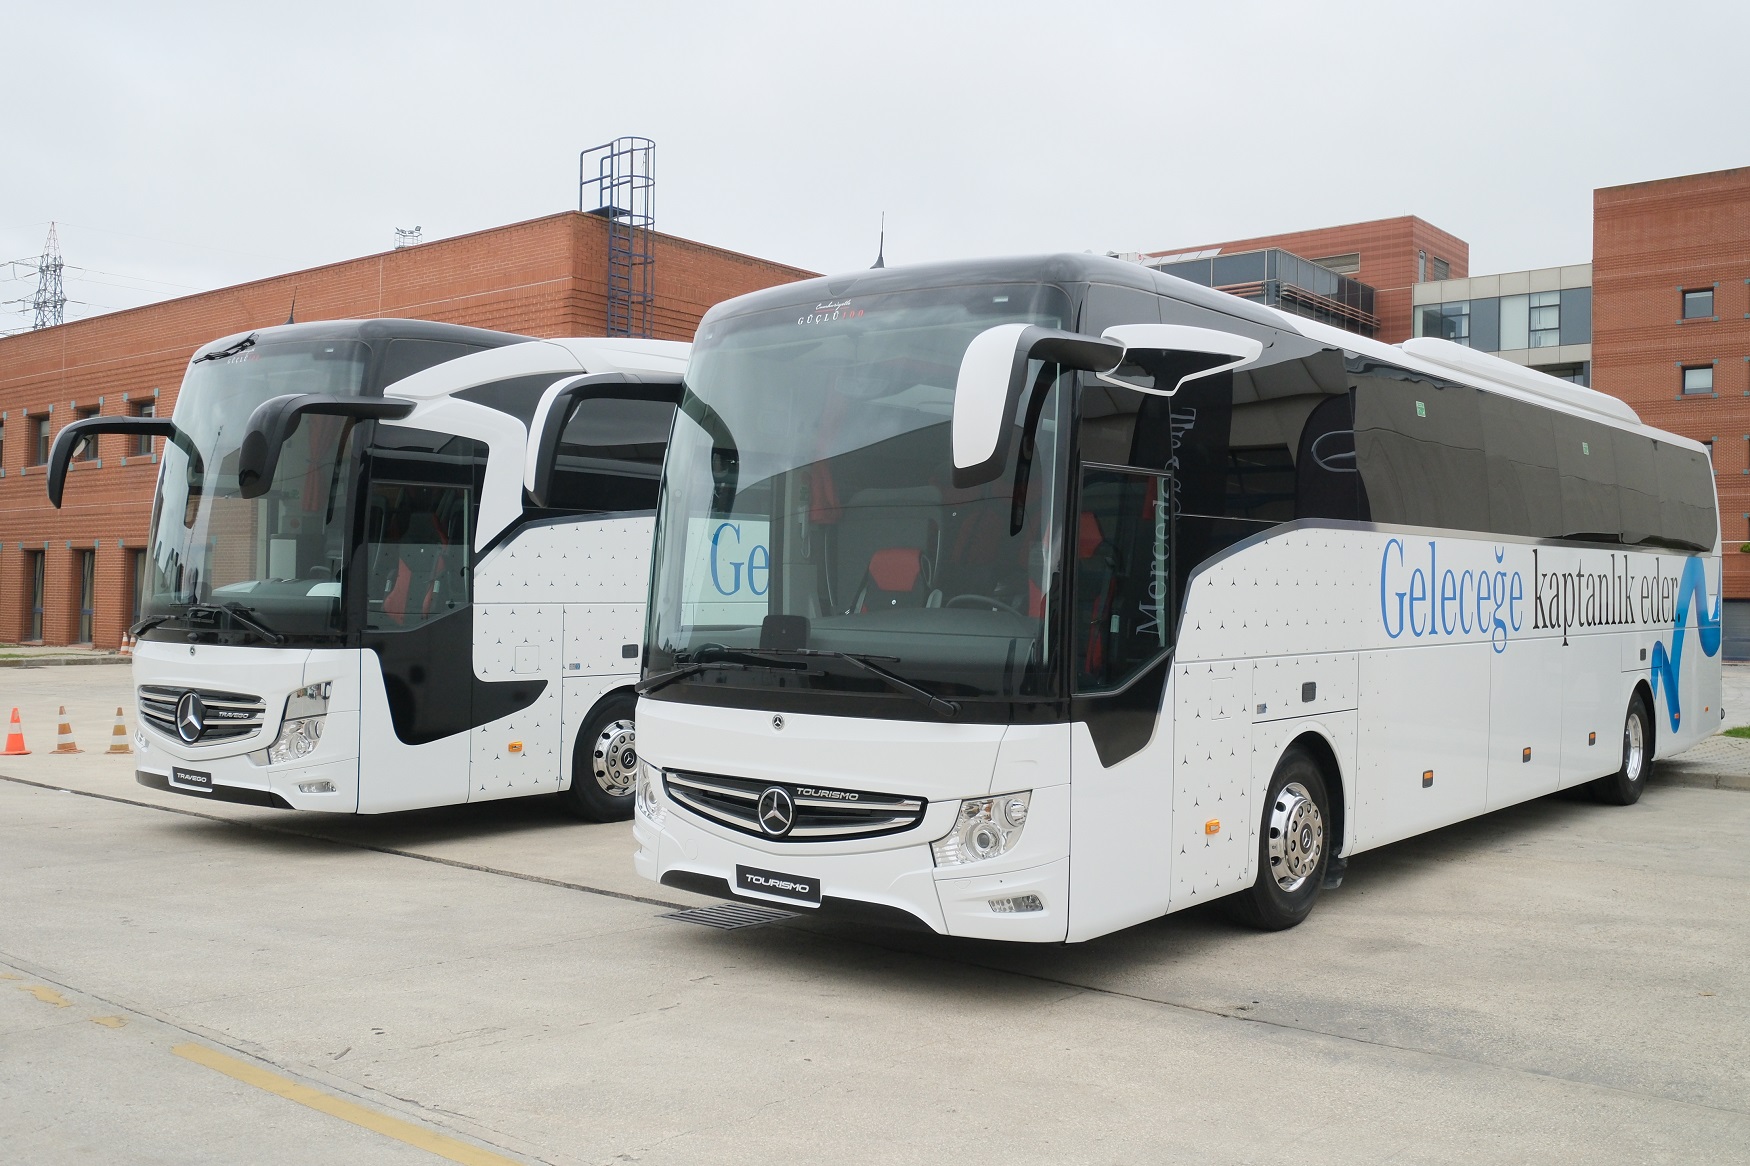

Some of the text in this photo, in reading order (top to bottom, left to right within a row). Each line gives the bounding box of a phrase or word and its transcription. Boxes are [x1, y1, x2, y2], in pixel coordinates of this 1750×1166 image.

[1380, 538, 1681, 654] Geleceğe kaptanlık eder.
[218, 711, 249, 719] TRAVEGO
[176, 772, 207, 783] TRAVEGO
[796, 787, 859, 801] TOURISMO
[745, 873, 810, 893] TOURISMO
